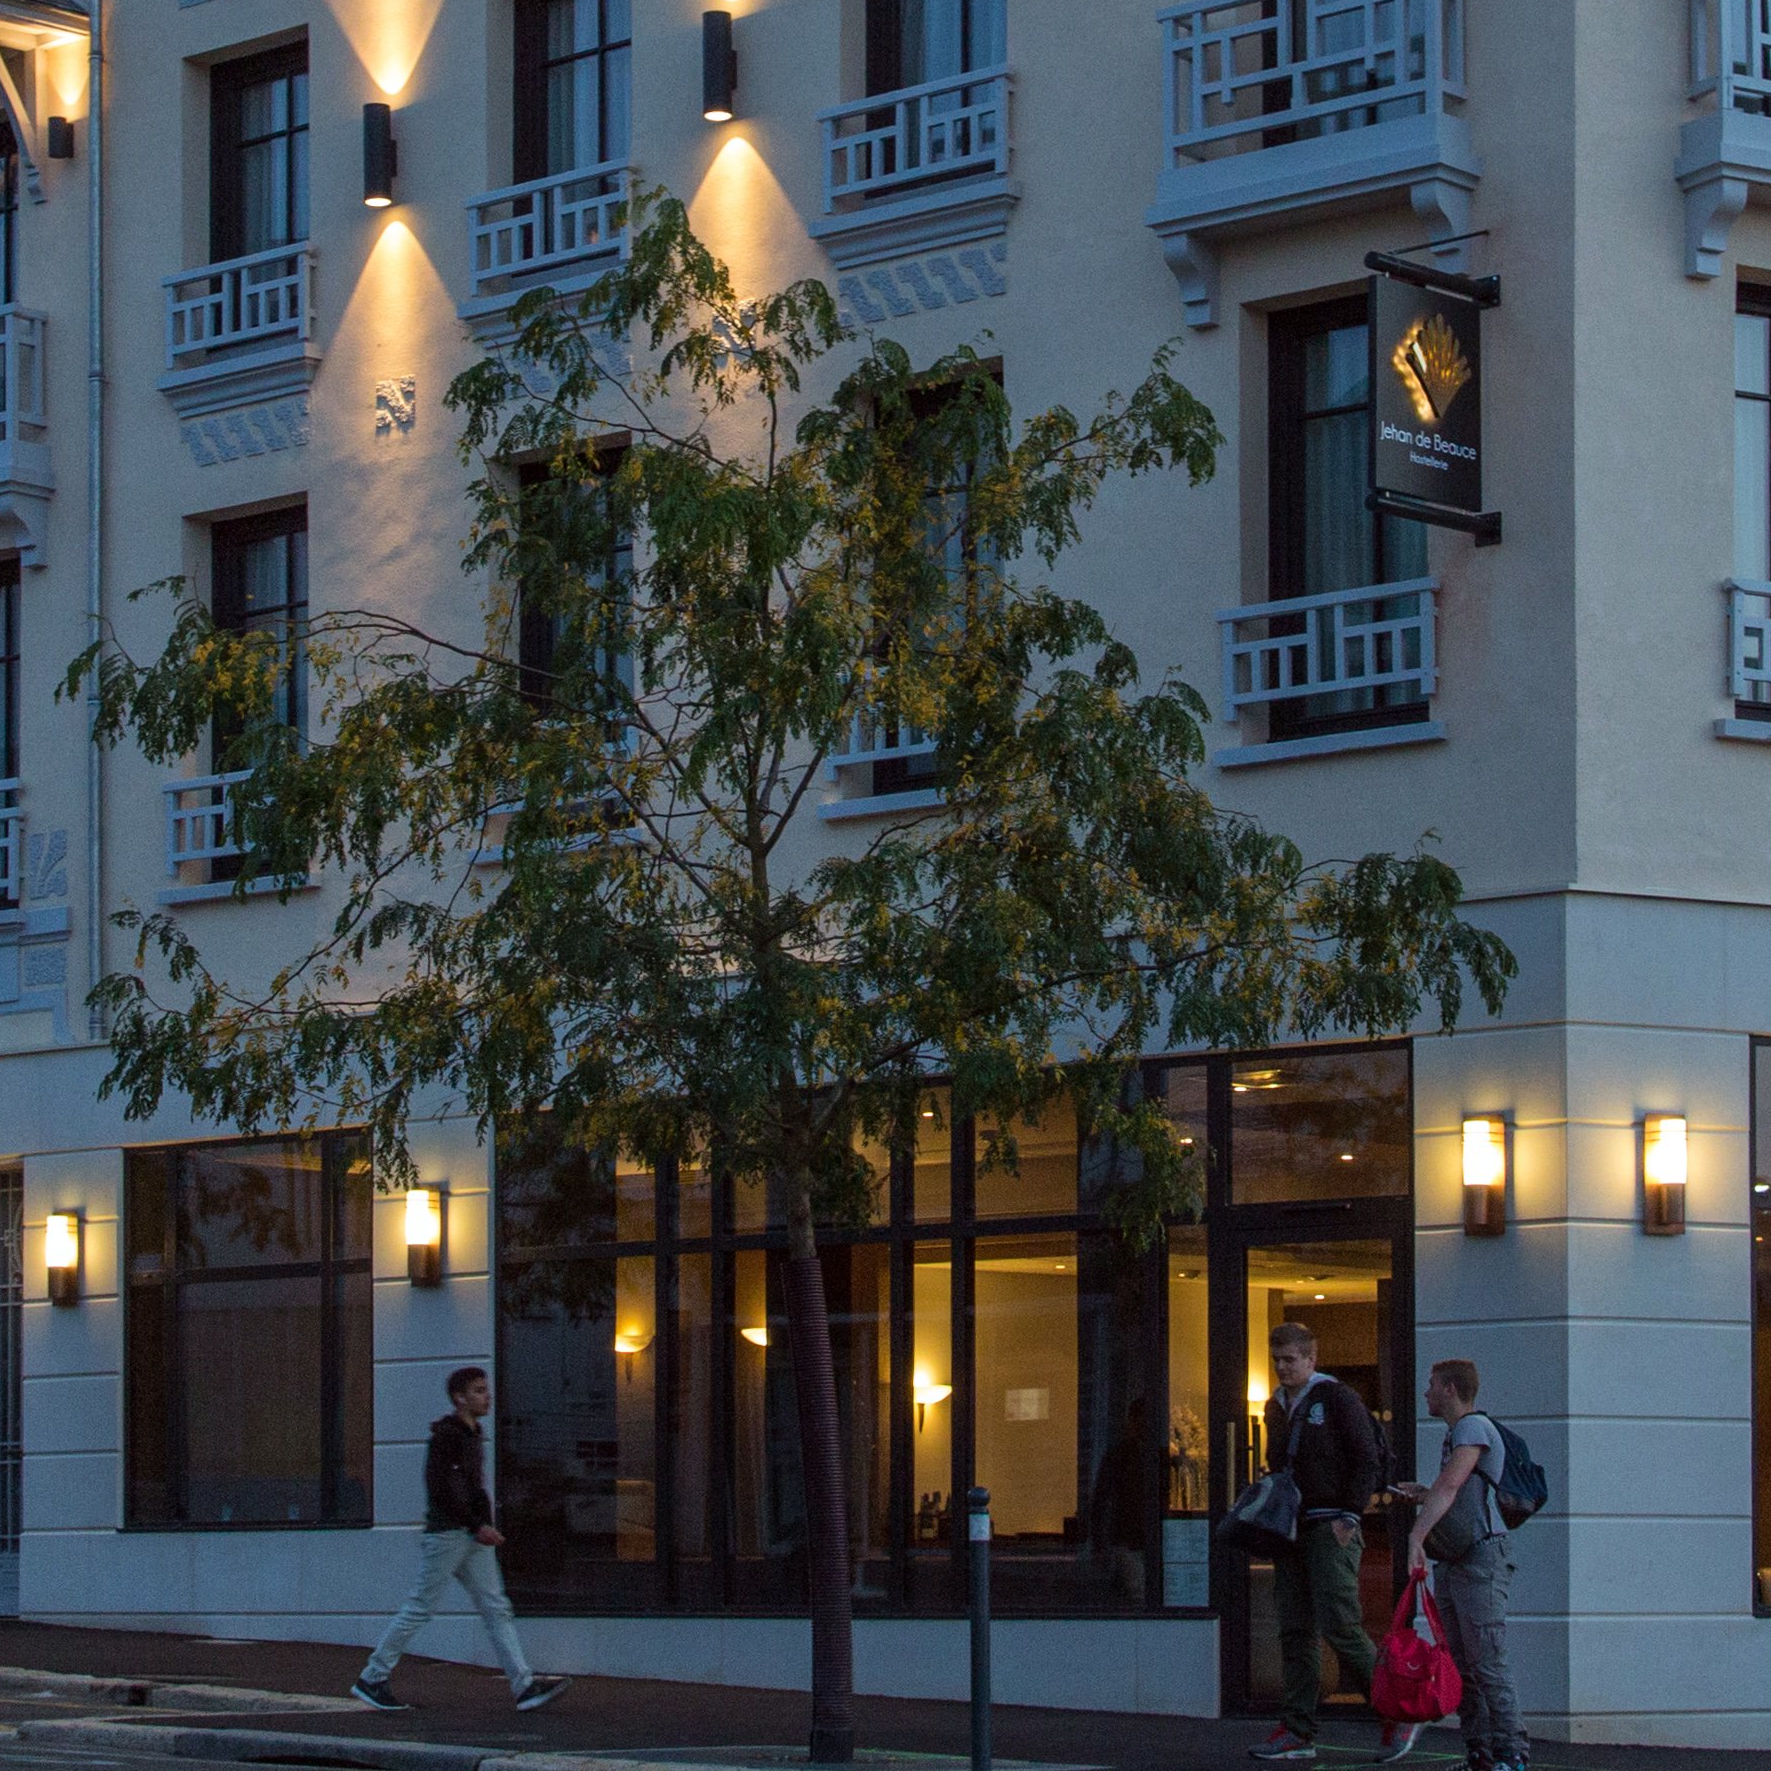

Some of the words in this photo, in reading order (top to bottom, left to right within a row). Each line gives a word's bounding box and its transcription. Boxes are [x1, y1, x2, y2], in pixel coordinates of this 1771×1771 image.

[1380, 421, 1413, 445] Jehan
[1415, 430, 1432, 449] de
[1433, 433, 1477, 461] Beauce
